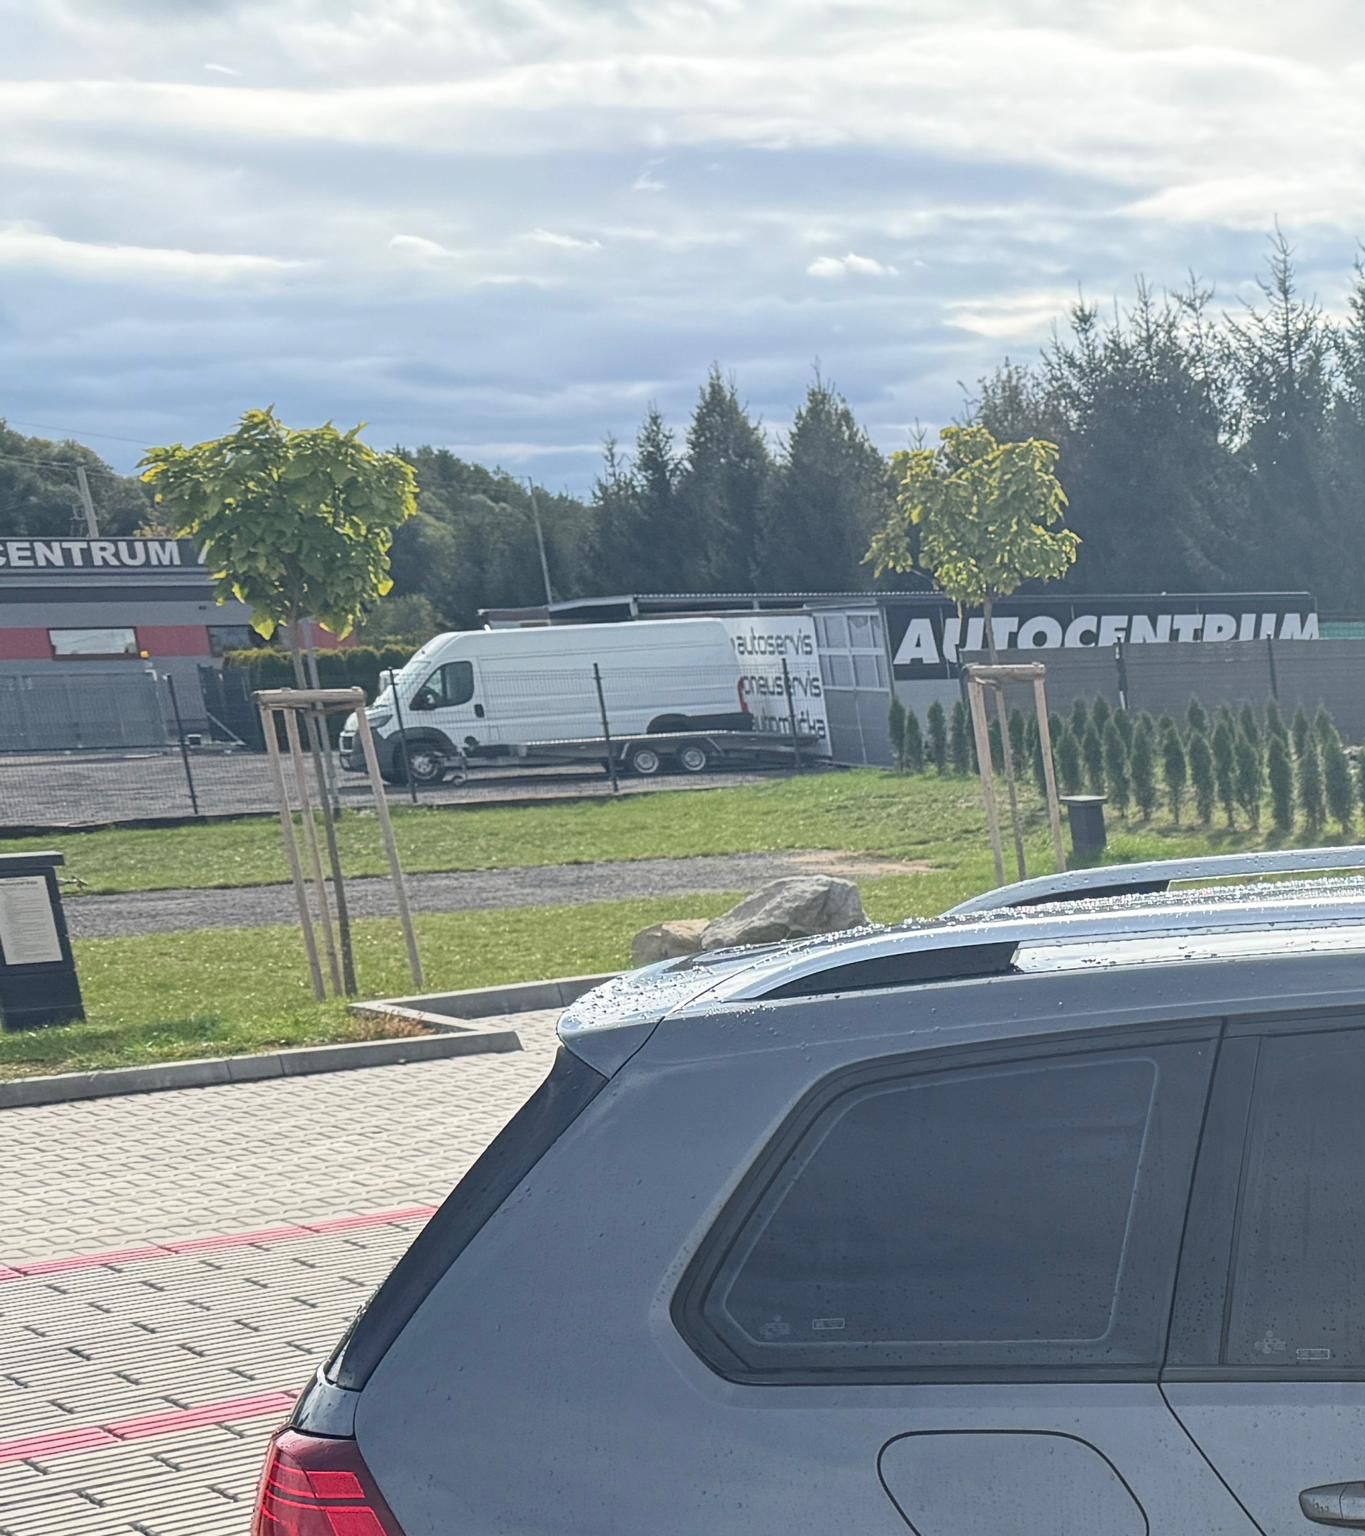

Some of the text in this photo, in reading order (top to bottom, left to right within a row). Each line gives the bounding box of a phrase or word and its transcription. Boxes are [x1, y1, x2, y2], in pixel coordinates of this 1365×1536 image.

[0, 541, 182, 567] ENTRUM
[736, 626, 813, 656] autoservis
[893, 613, 1320, 664] AUTOCENTRUM
[743, 669, 822, 697] pneusrvis
[752, 706, 826, 739] utomčka
